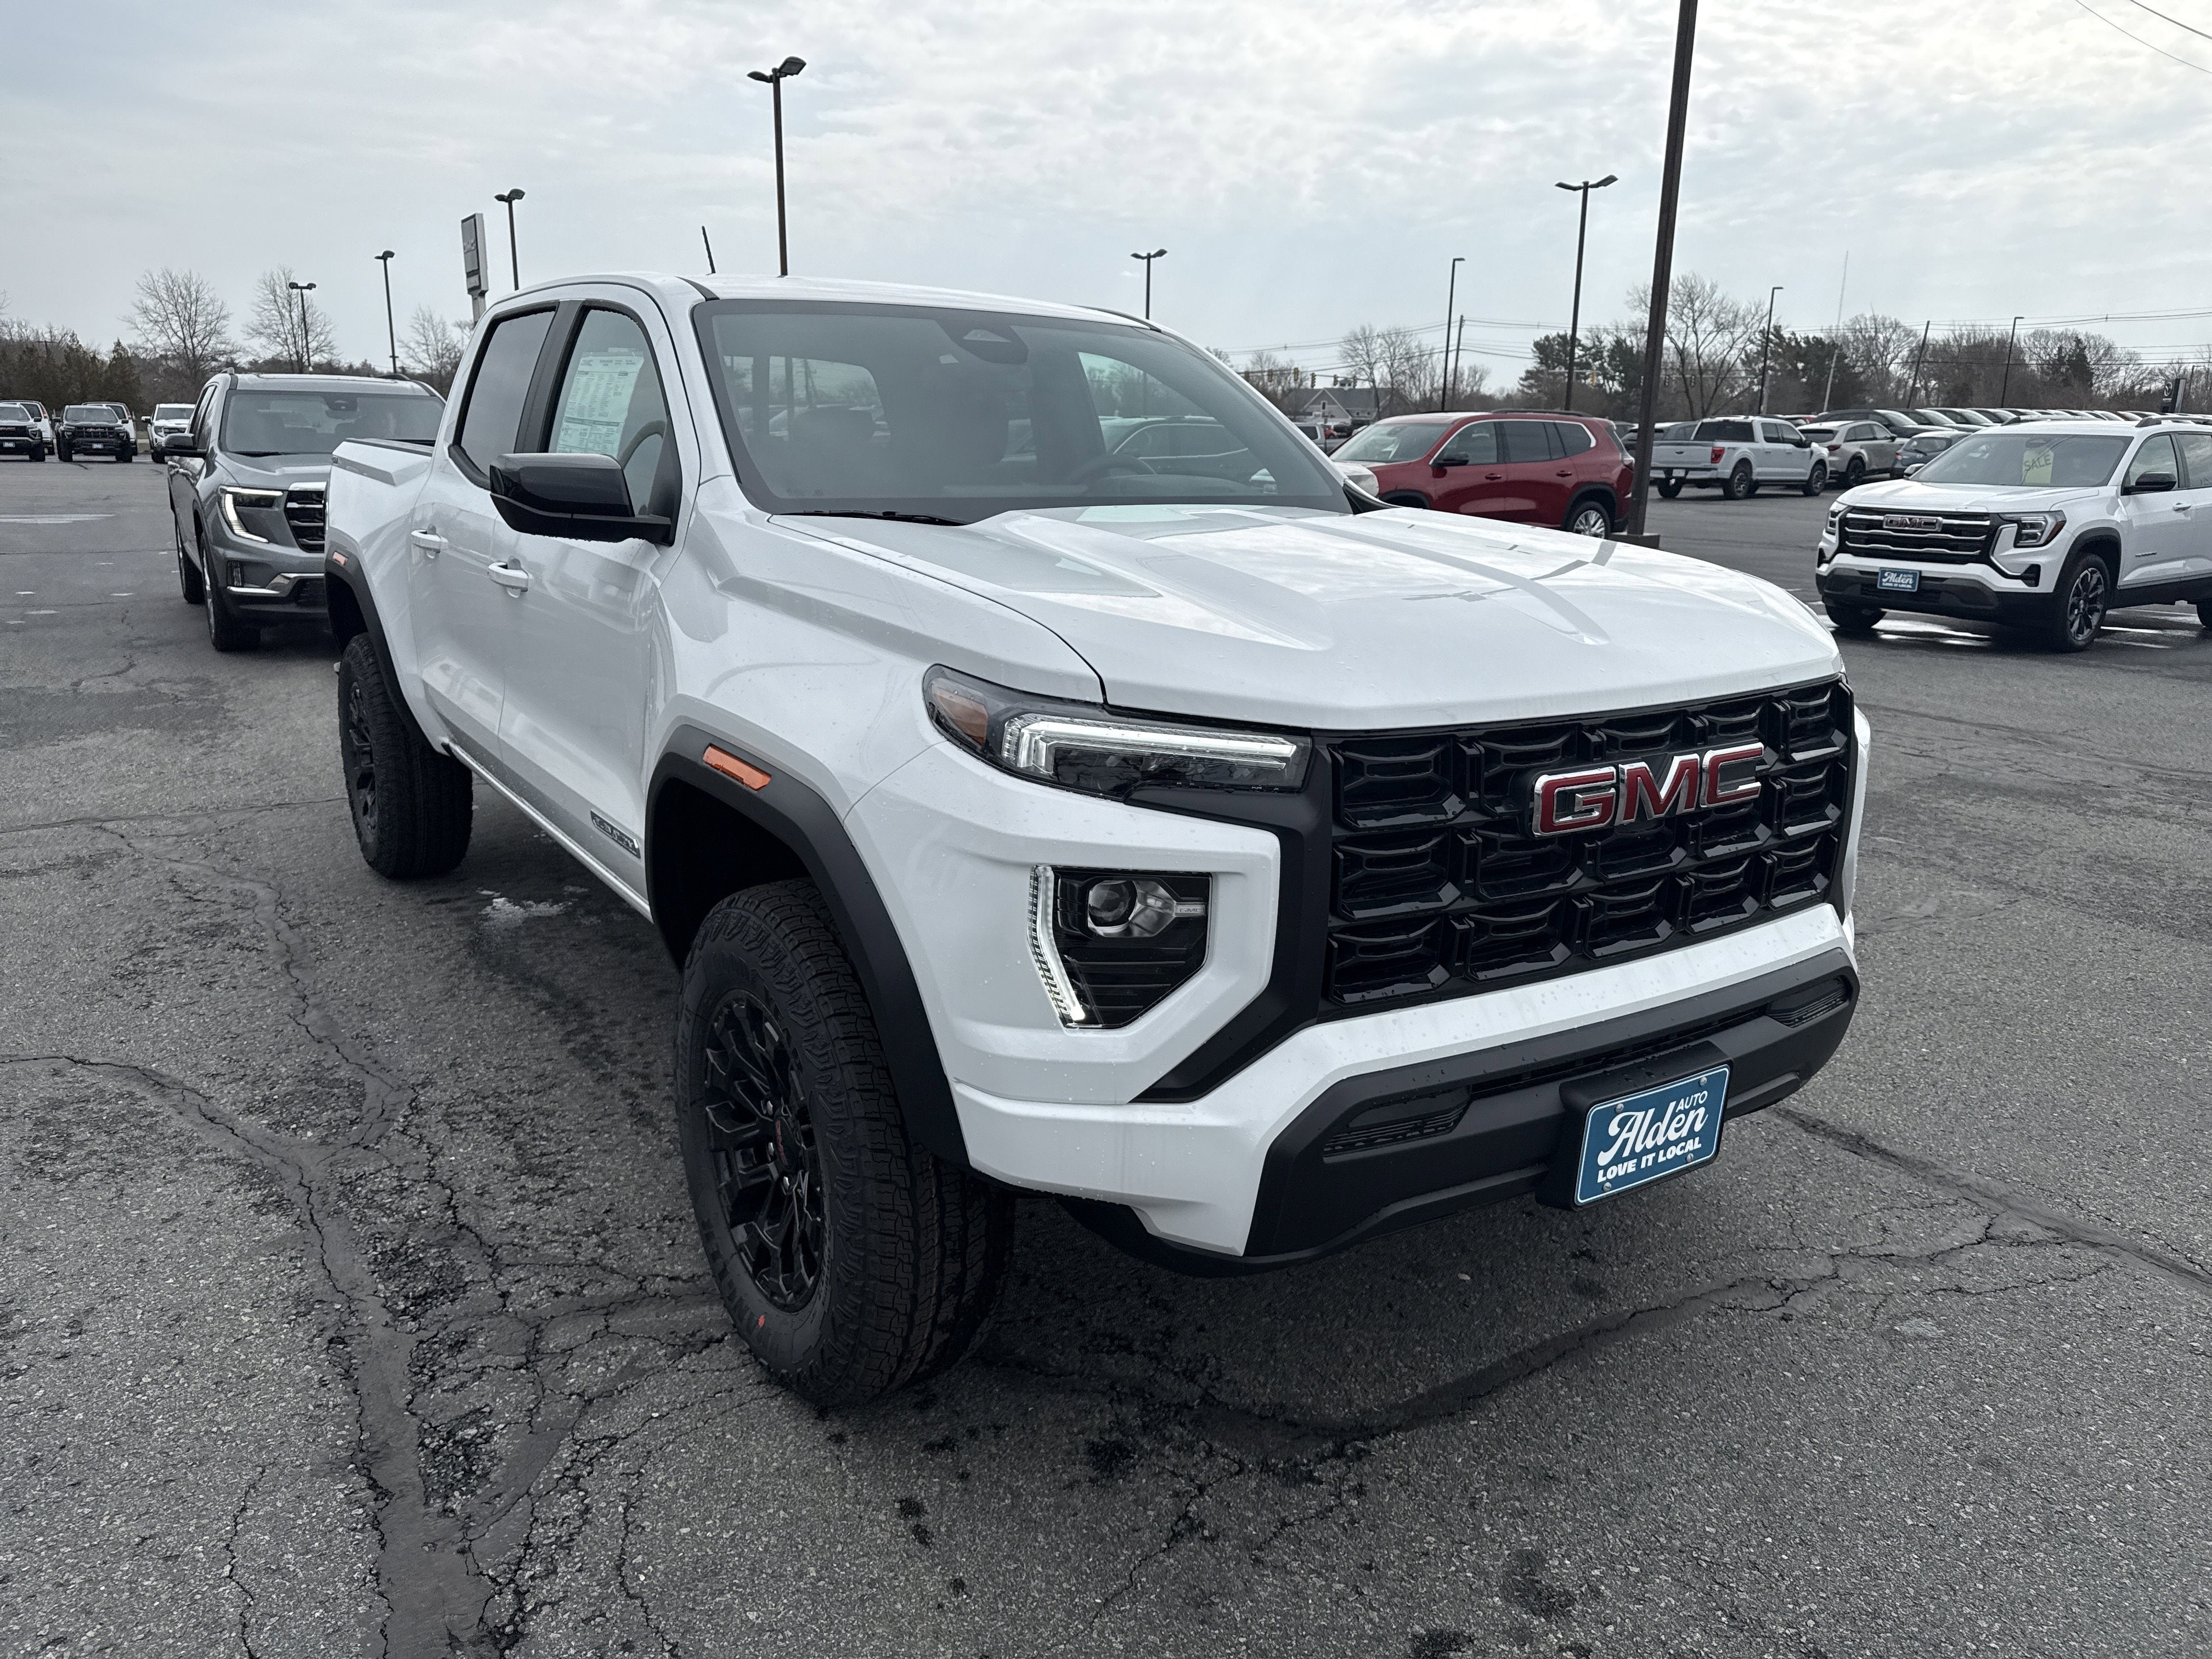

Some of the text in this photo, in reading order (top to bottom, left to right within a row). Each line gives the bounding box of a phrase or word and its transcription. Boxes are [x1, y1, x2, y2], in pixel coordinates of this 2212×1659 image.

[2024, 454, 2052, 469] SALE
[1887, 516, 1937, 529] GMC
[1882, 571, 1914, 584] Alden
[1532, 742, 1765, 838] GMC
[1675, 1090, 1708, 1113] AUTO
[1597, 1101, 1709, 1166] Alden
[1597, 1137, 1702, 1183] LOVE IT LOCAL
